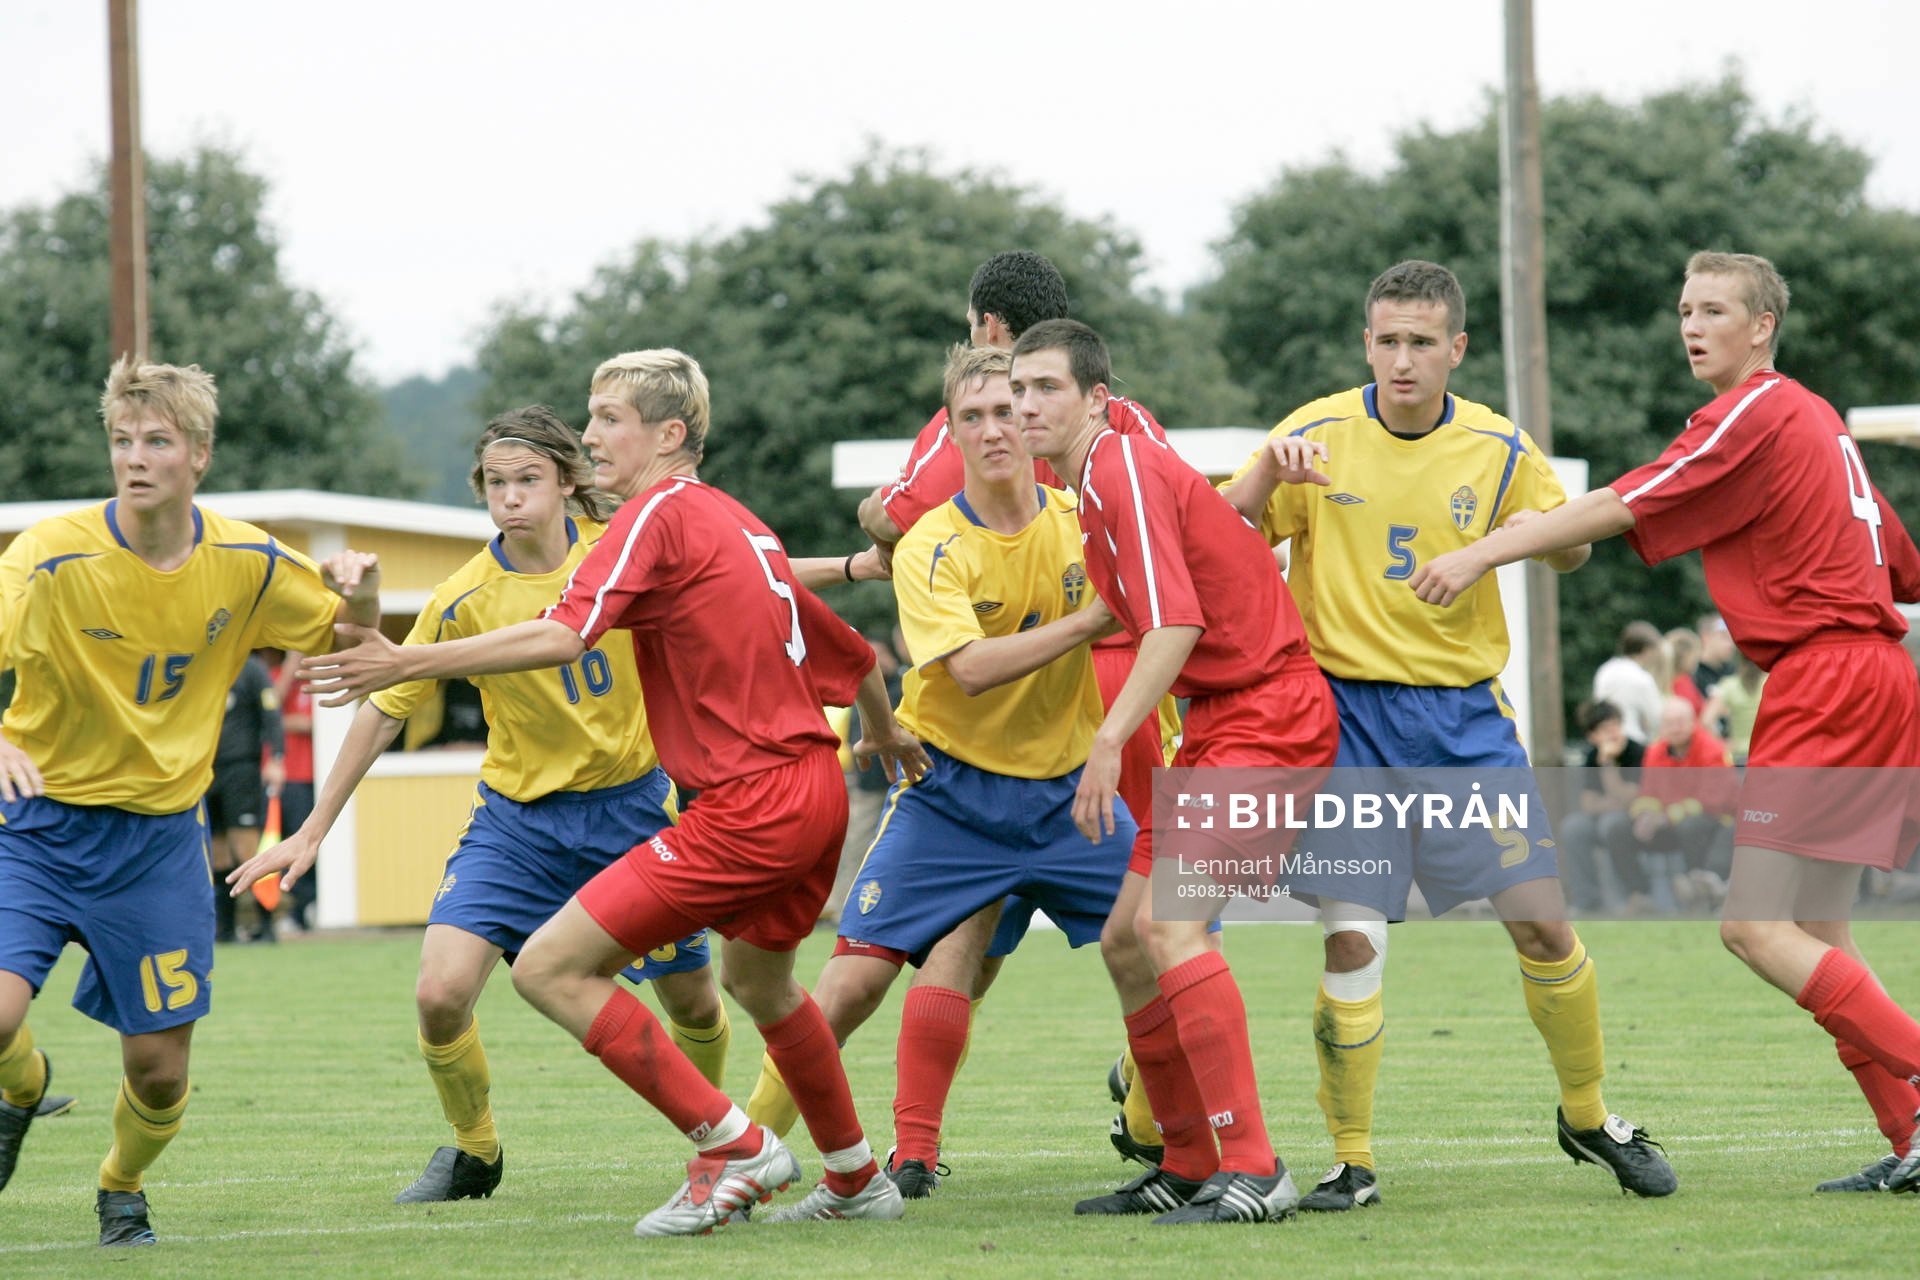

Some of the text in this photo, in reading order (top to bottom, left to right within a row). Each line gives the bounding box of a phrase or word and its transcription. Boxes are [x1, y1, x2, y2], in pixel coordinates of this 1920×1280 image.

[1837, 433, 1883, 567] 4
[1384, 523, 1419, 580] 5
[741, 527, 807, 668] 5
[135, 653, 195, 705] 15
[560, 648, 613, 705] 10
[649, 835, 673, 862] TICO
[140, 948, 198, 1013] 15
